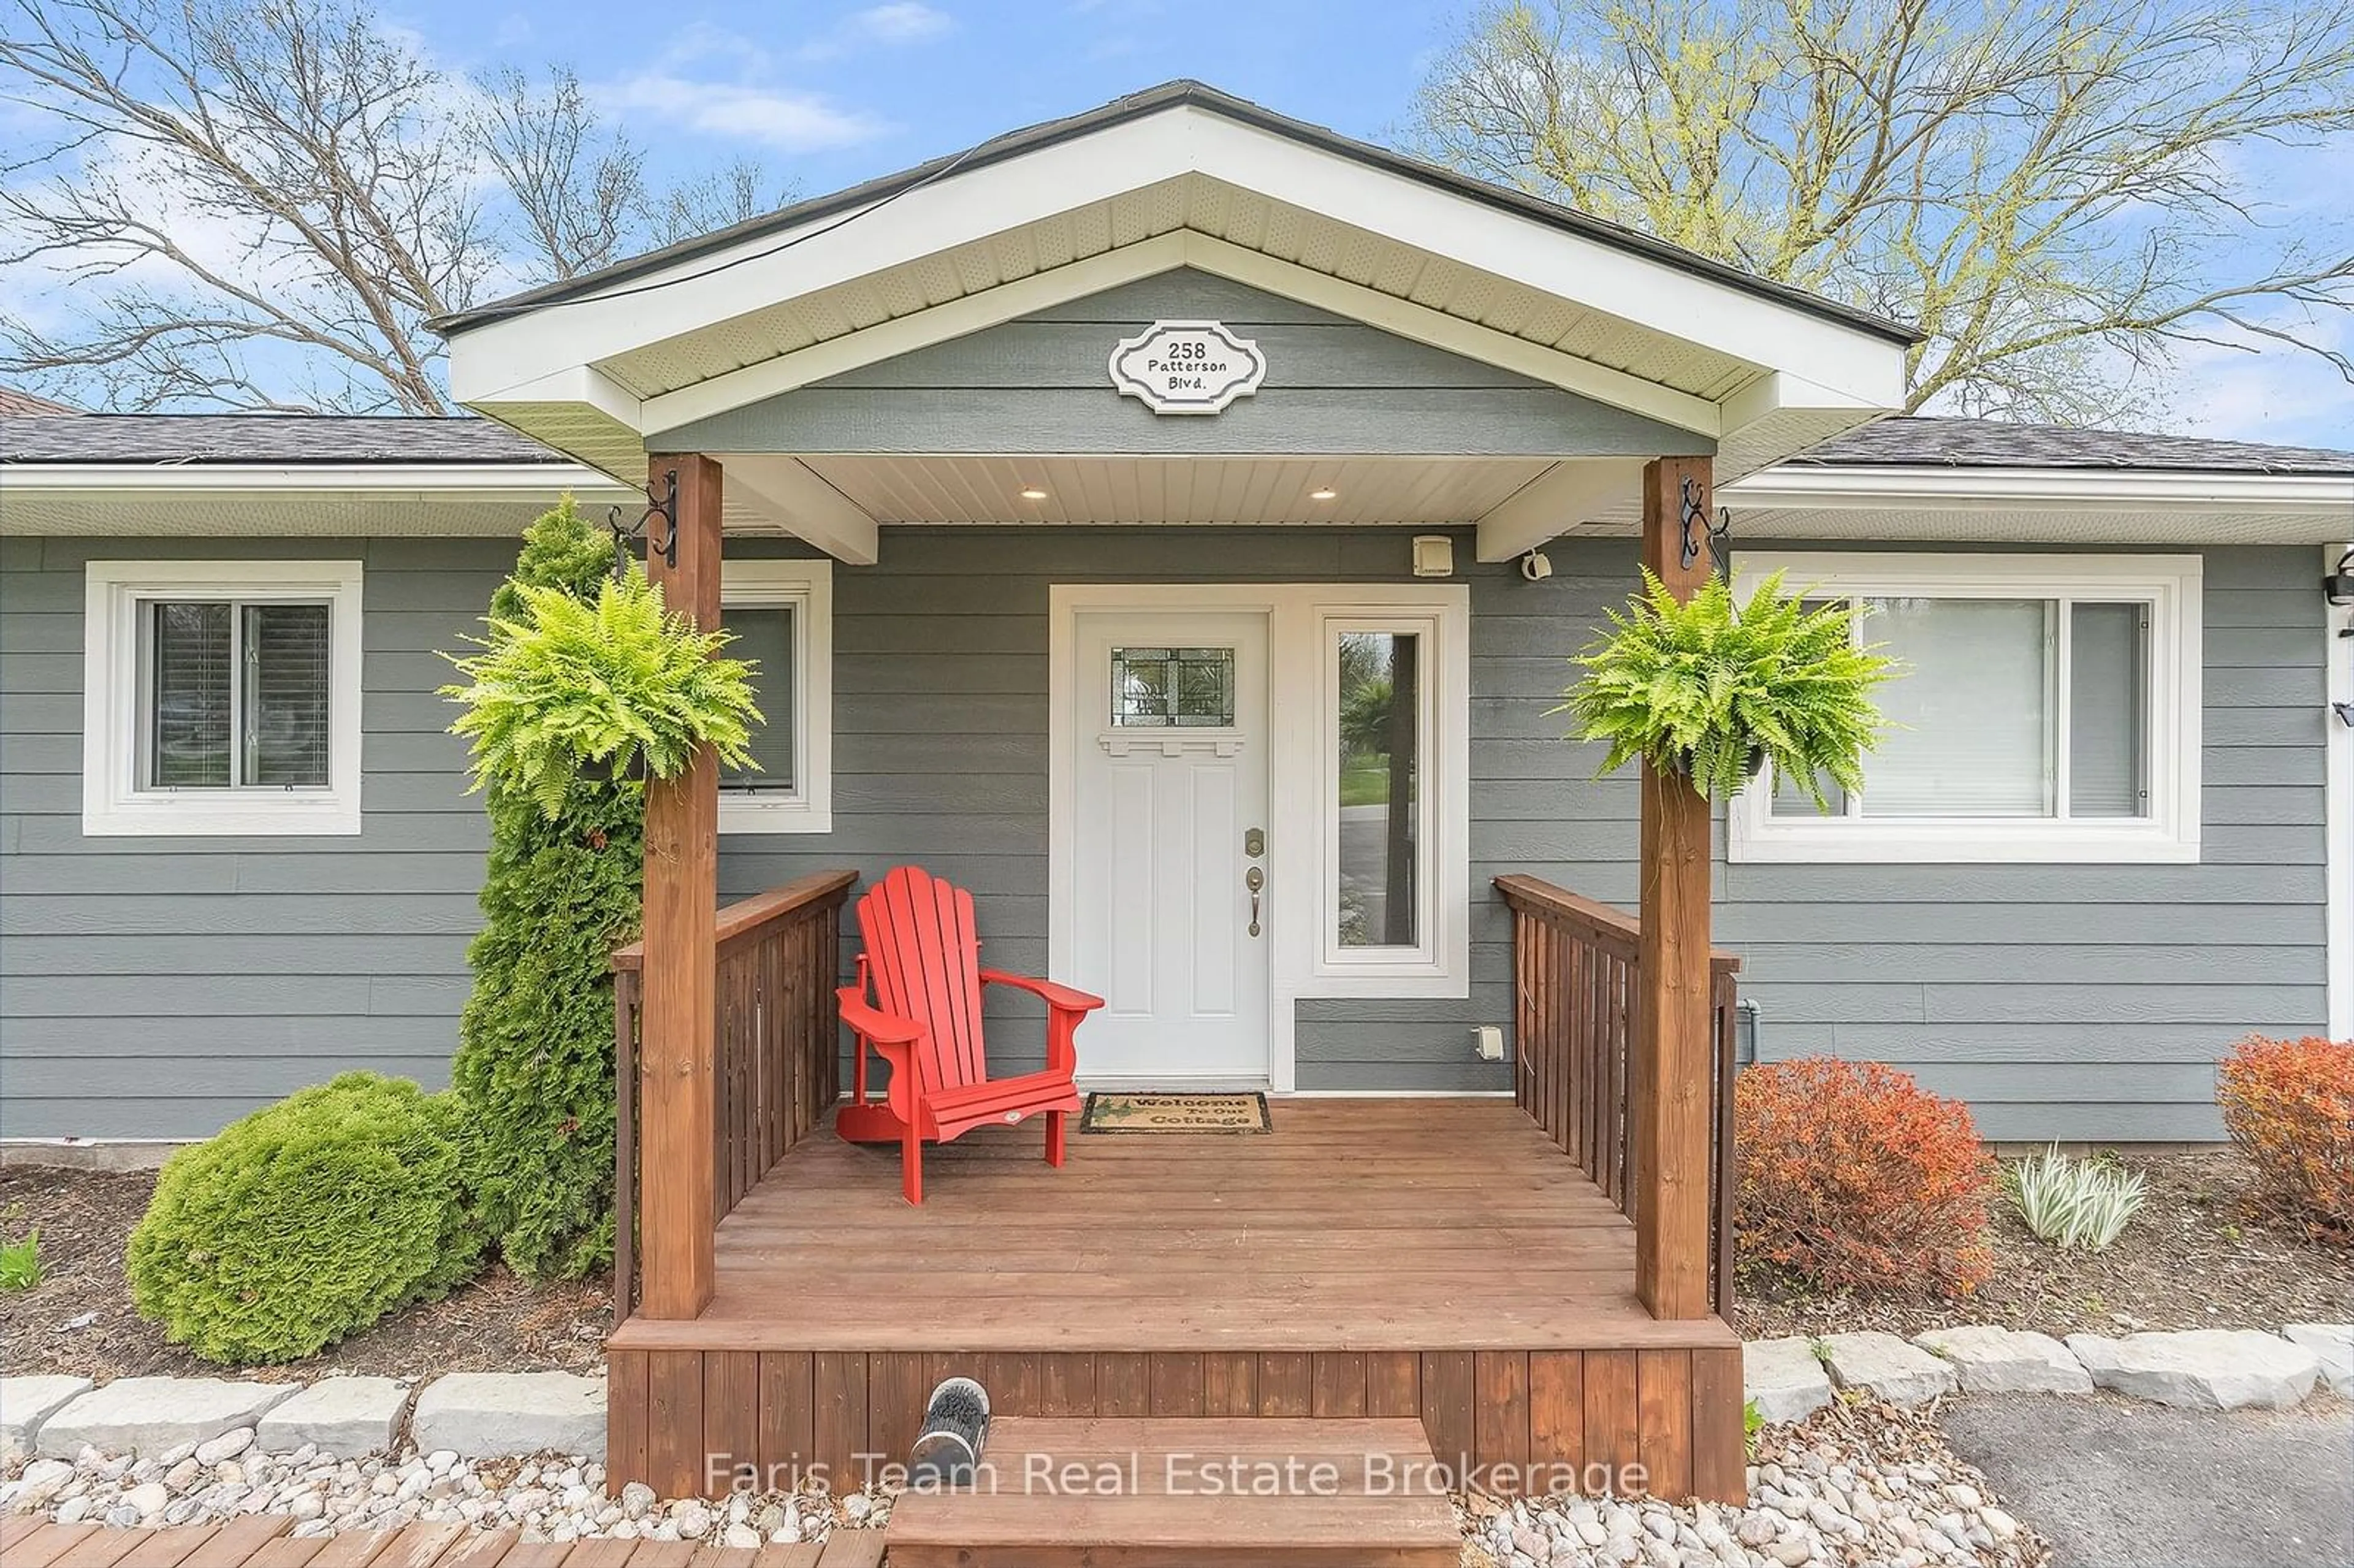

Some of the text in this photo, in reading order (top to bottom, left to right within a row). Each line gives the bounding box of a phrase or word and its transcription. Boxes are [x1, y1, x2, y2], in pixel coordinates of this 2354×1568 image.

[1168, 343, 1206, 359] 258
[1148, 360, 1227, 371] Patterson
[1168, 376, 1206, 389] Blvd.
[1135, 1098, 1248, 1107] Welcome
[1149, 1116, 1250, 1126] Cottage
